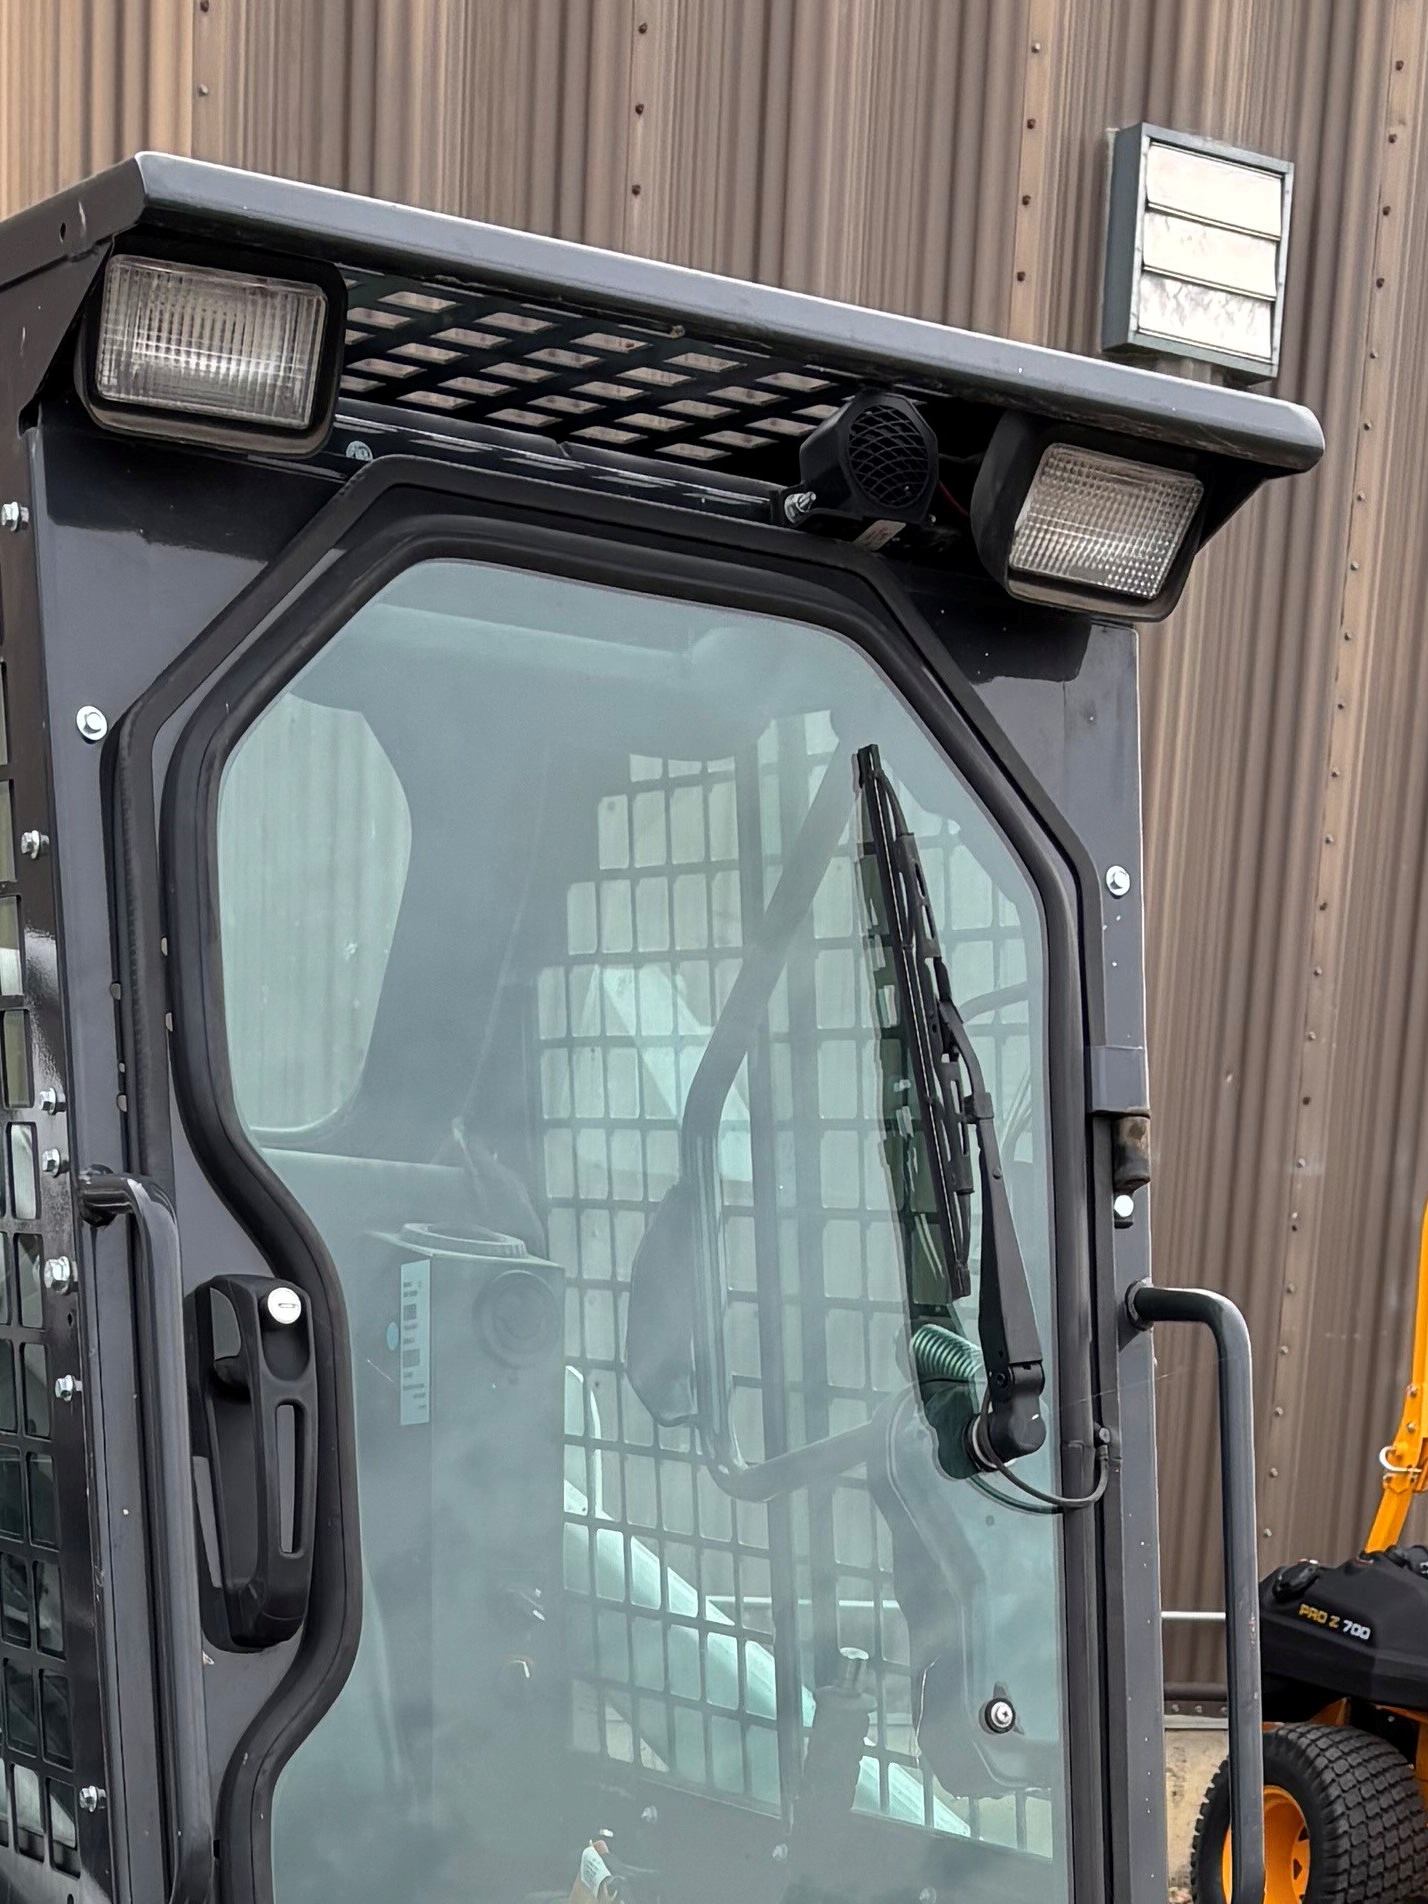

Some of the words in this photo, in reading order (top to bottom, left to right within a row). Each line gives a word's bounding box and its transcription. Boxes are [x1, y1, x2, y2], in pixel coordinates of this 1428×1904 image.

[1298, 1603, 1328, 1624] PRO
[1329, 1615, 1341, 1628] Z
[1342, 1619, 1371, 1640] 700
